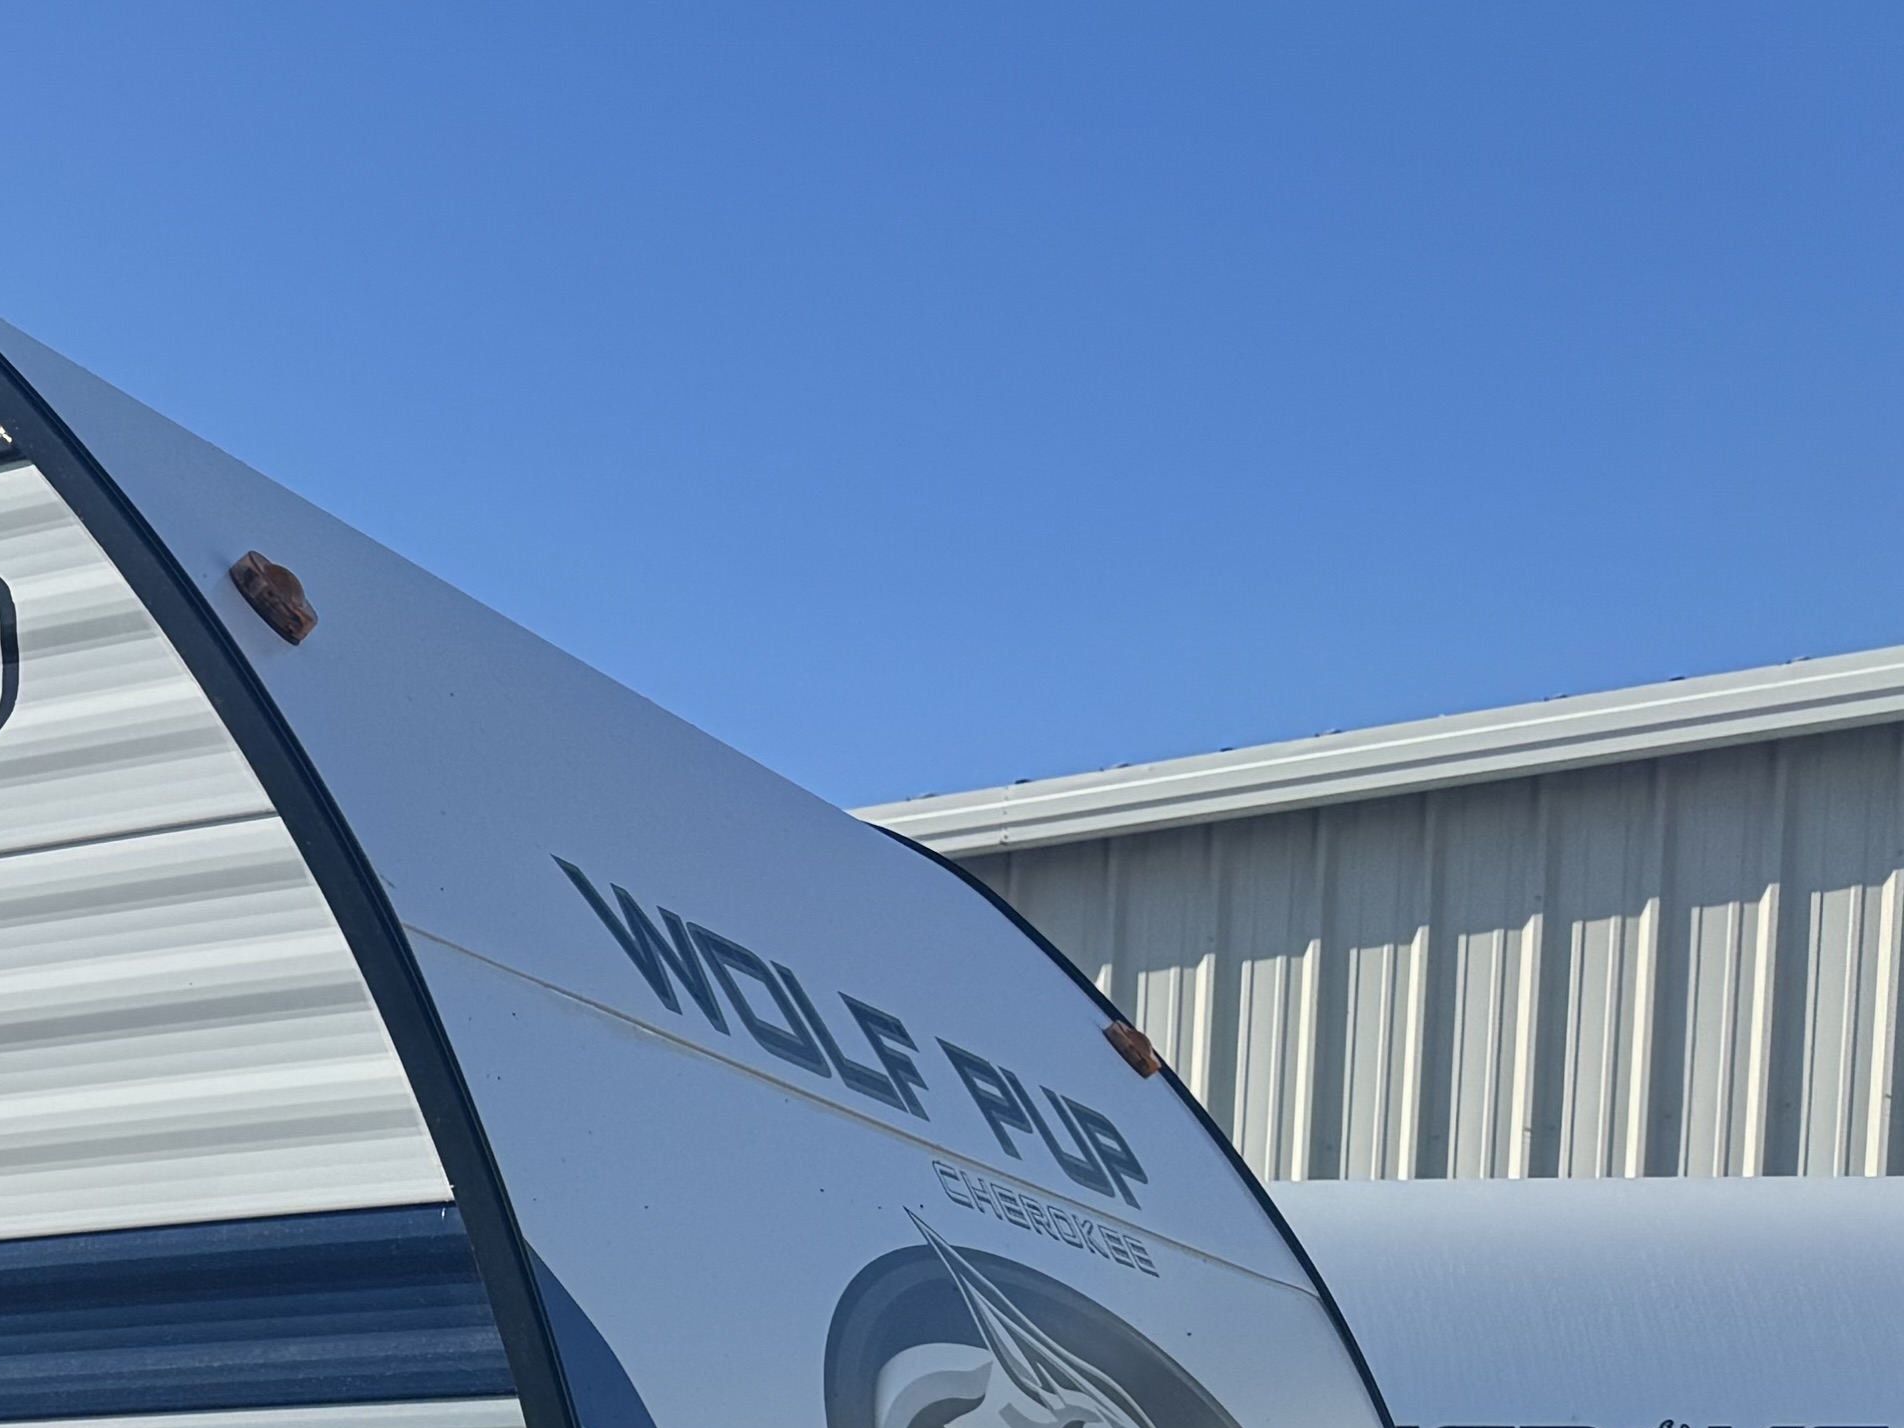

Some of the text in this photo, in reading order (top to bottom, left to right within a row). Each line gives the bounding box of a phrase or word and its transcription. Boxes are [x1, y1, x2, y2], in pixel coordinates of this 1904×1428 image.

[549, 853, 1149, 1211] WOLF PUP
[931, 1160, 1160, 1278] CHEROKEE
